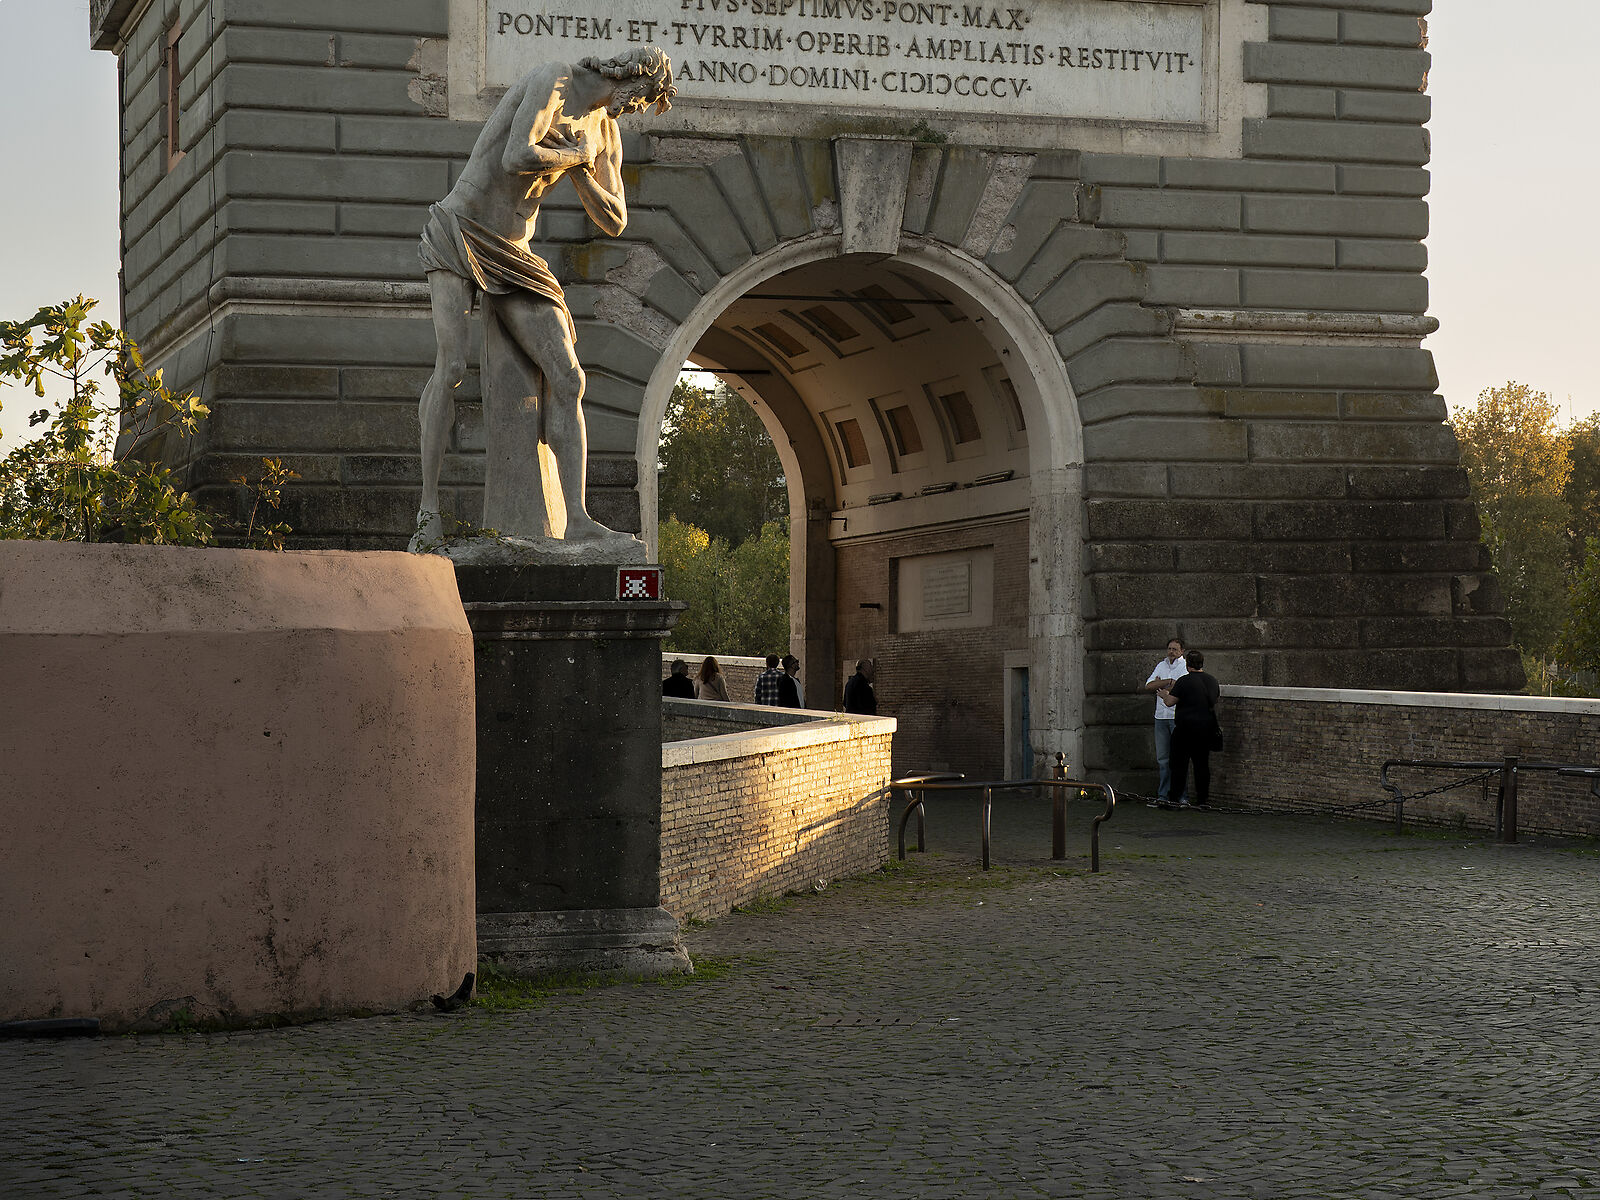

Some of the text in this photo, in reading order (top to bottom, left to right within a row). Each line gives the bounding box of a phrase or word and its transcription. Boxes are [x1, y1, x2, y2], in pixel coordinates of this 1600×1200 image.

[883, 0, 952, 26] PONT
[961, 5, 1025, 31] MAX
[497, 11, 1189, 73] PONTEM ET TVRRIM OPERIB AMPLIATIS RESTITVIT
[676, 60, 757, 83] ANNO
[769, 64, 871, 91] DOMINI
